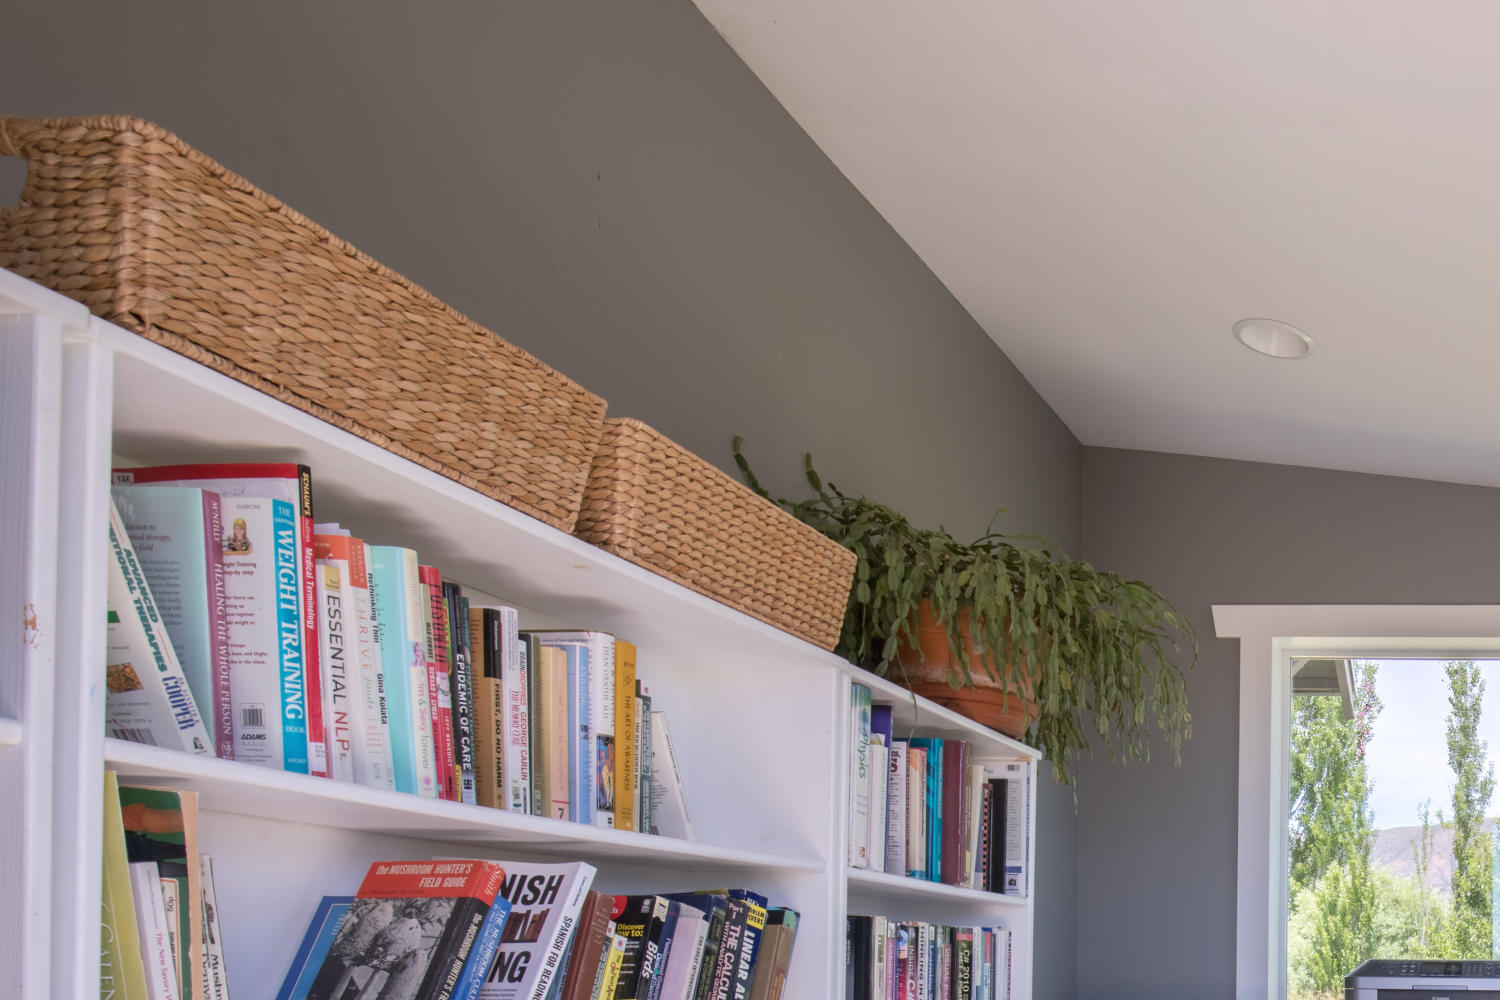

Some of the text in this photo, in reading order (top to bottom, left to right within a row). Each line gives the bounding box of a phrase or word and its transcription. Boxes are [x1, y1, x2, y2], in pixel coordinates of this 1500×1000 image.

[302, 472, 312, 516] SCHAUM'S
[123, 548, 159, 623] ADVANCED
[305, 547, 318, 630] Medical Terminology
[368, 573, 377, 621] Rethinking
[133, 596, 168, 672] THERAPIES
[217, 620, 227, 640] THE
[278, 530, 305, 733] WEIGHT TRAINING BOOK
[372, 625, 380, 643] Thin
[219, 645, 230, 686] WHOLE
[327, 595, 350, 752] ESSENTIAL NLP
[377, 674, 385, 693] Gina
[162, 676, 195, 730] COOPER
[221, 689, 232, 734] PERSON
[456, 654, 472, 770] EPIDEMIC OF CARE
[496, 718, 501, 735] DO
[496, 737, 502, 754] NO
[625, 731, 631, 742] OF
[624, 745, 632, 790] AWARENESS
[857, 734, 870, 779] Physics
[376, 863, 473, 875] the MUSHROOM HUNTER'S
[419, 876, 467, 888] FIELD GUIDE
[472, 913, 482, 924] the
[496, 910, 506, 928] THE
[555, 915, 573, 951] SPANISH
[730, 924, 741, 947] THE
[458, 923, 478, 960] MUSHROOM
[642, 941, 659, 980] Birds
[737, 928, 756, 980] LINEAR
[161, 967, 170, 993] Savory
[443, 959, 463, 992] HUNTER'S
[546, 951, 561, 971] FOR
[962, 949, 970, 993] C# 2010
